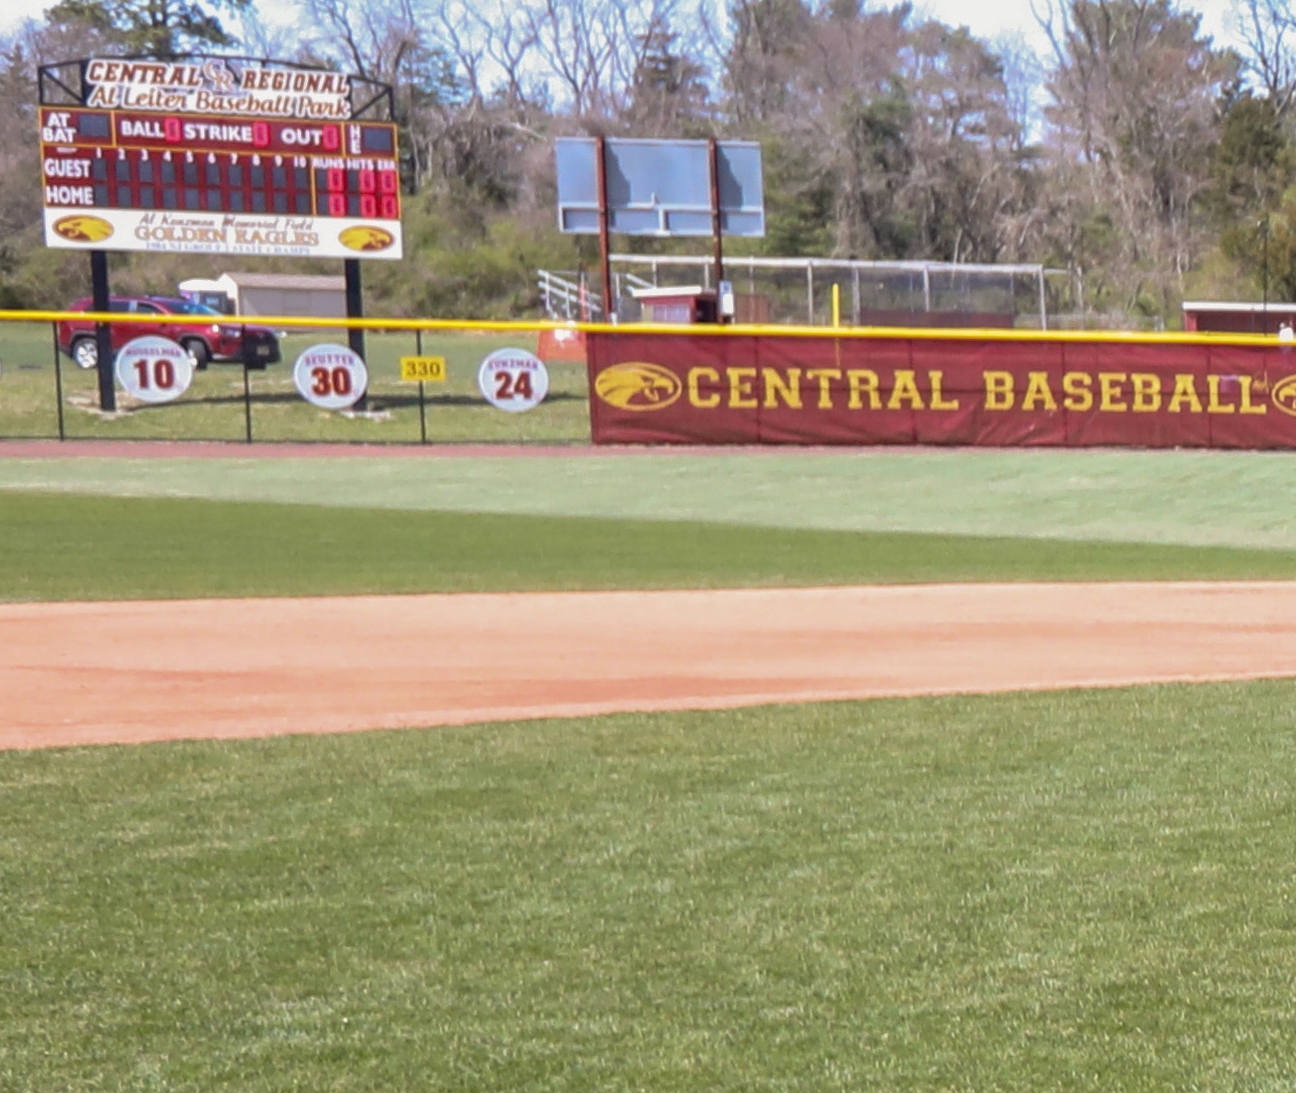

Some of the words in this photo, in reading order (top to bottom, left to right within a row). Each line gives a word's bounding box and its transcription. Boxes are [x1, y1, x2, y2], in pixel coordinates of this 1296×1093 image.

[89, 61, 201, 86] CENTRAL
[243, 69, 347, 94] REGIONAL
[91, 85, 116, 105] Al
[124, 86, 188, 109] Leiter
[196, 90, 290, 114] Baseball
[299, 97, 349, 117] Park
[48, 113, 70, 127] AT
[121, 120, 165, 138] BALL
[42, 127, 76, 142] BAT
[184, 124, 253, 142] STRIKE
[281, 128, 323, 145] OUT
[44, 159, 91, 177] GUEST
[96, 148, 102, 159] 1
[118, 148, 126, 160] 2
[141, 148, 149, 161] 3
[163, 150, 172, 162] 4
[186, 152, 194, 163] 5
[208, 153, 216, 164] 6
[231, 154, 239, 164] 7
[253, 155, 261, 166] 8
[275, 155, 283, 166] 9
[294, 156, 307, 168] 10
[312, 156, 344, 169] RUNS
[347, 159, 374, 170] HITS
[46, 186, 94, 205] HOME
[135, 225, 228, 243] GOLDEN
[235, 229, 319, 246] EAGLES
[135, 359, 174, 390] 10
[406, 361, 440, 376] 330
[311, 366, 351, 397] 30
[495, 370, 532, 400] 24
[688, 366, 960, 411] CENTRAL
[983, 370, 1267, 415] BASEBALL
